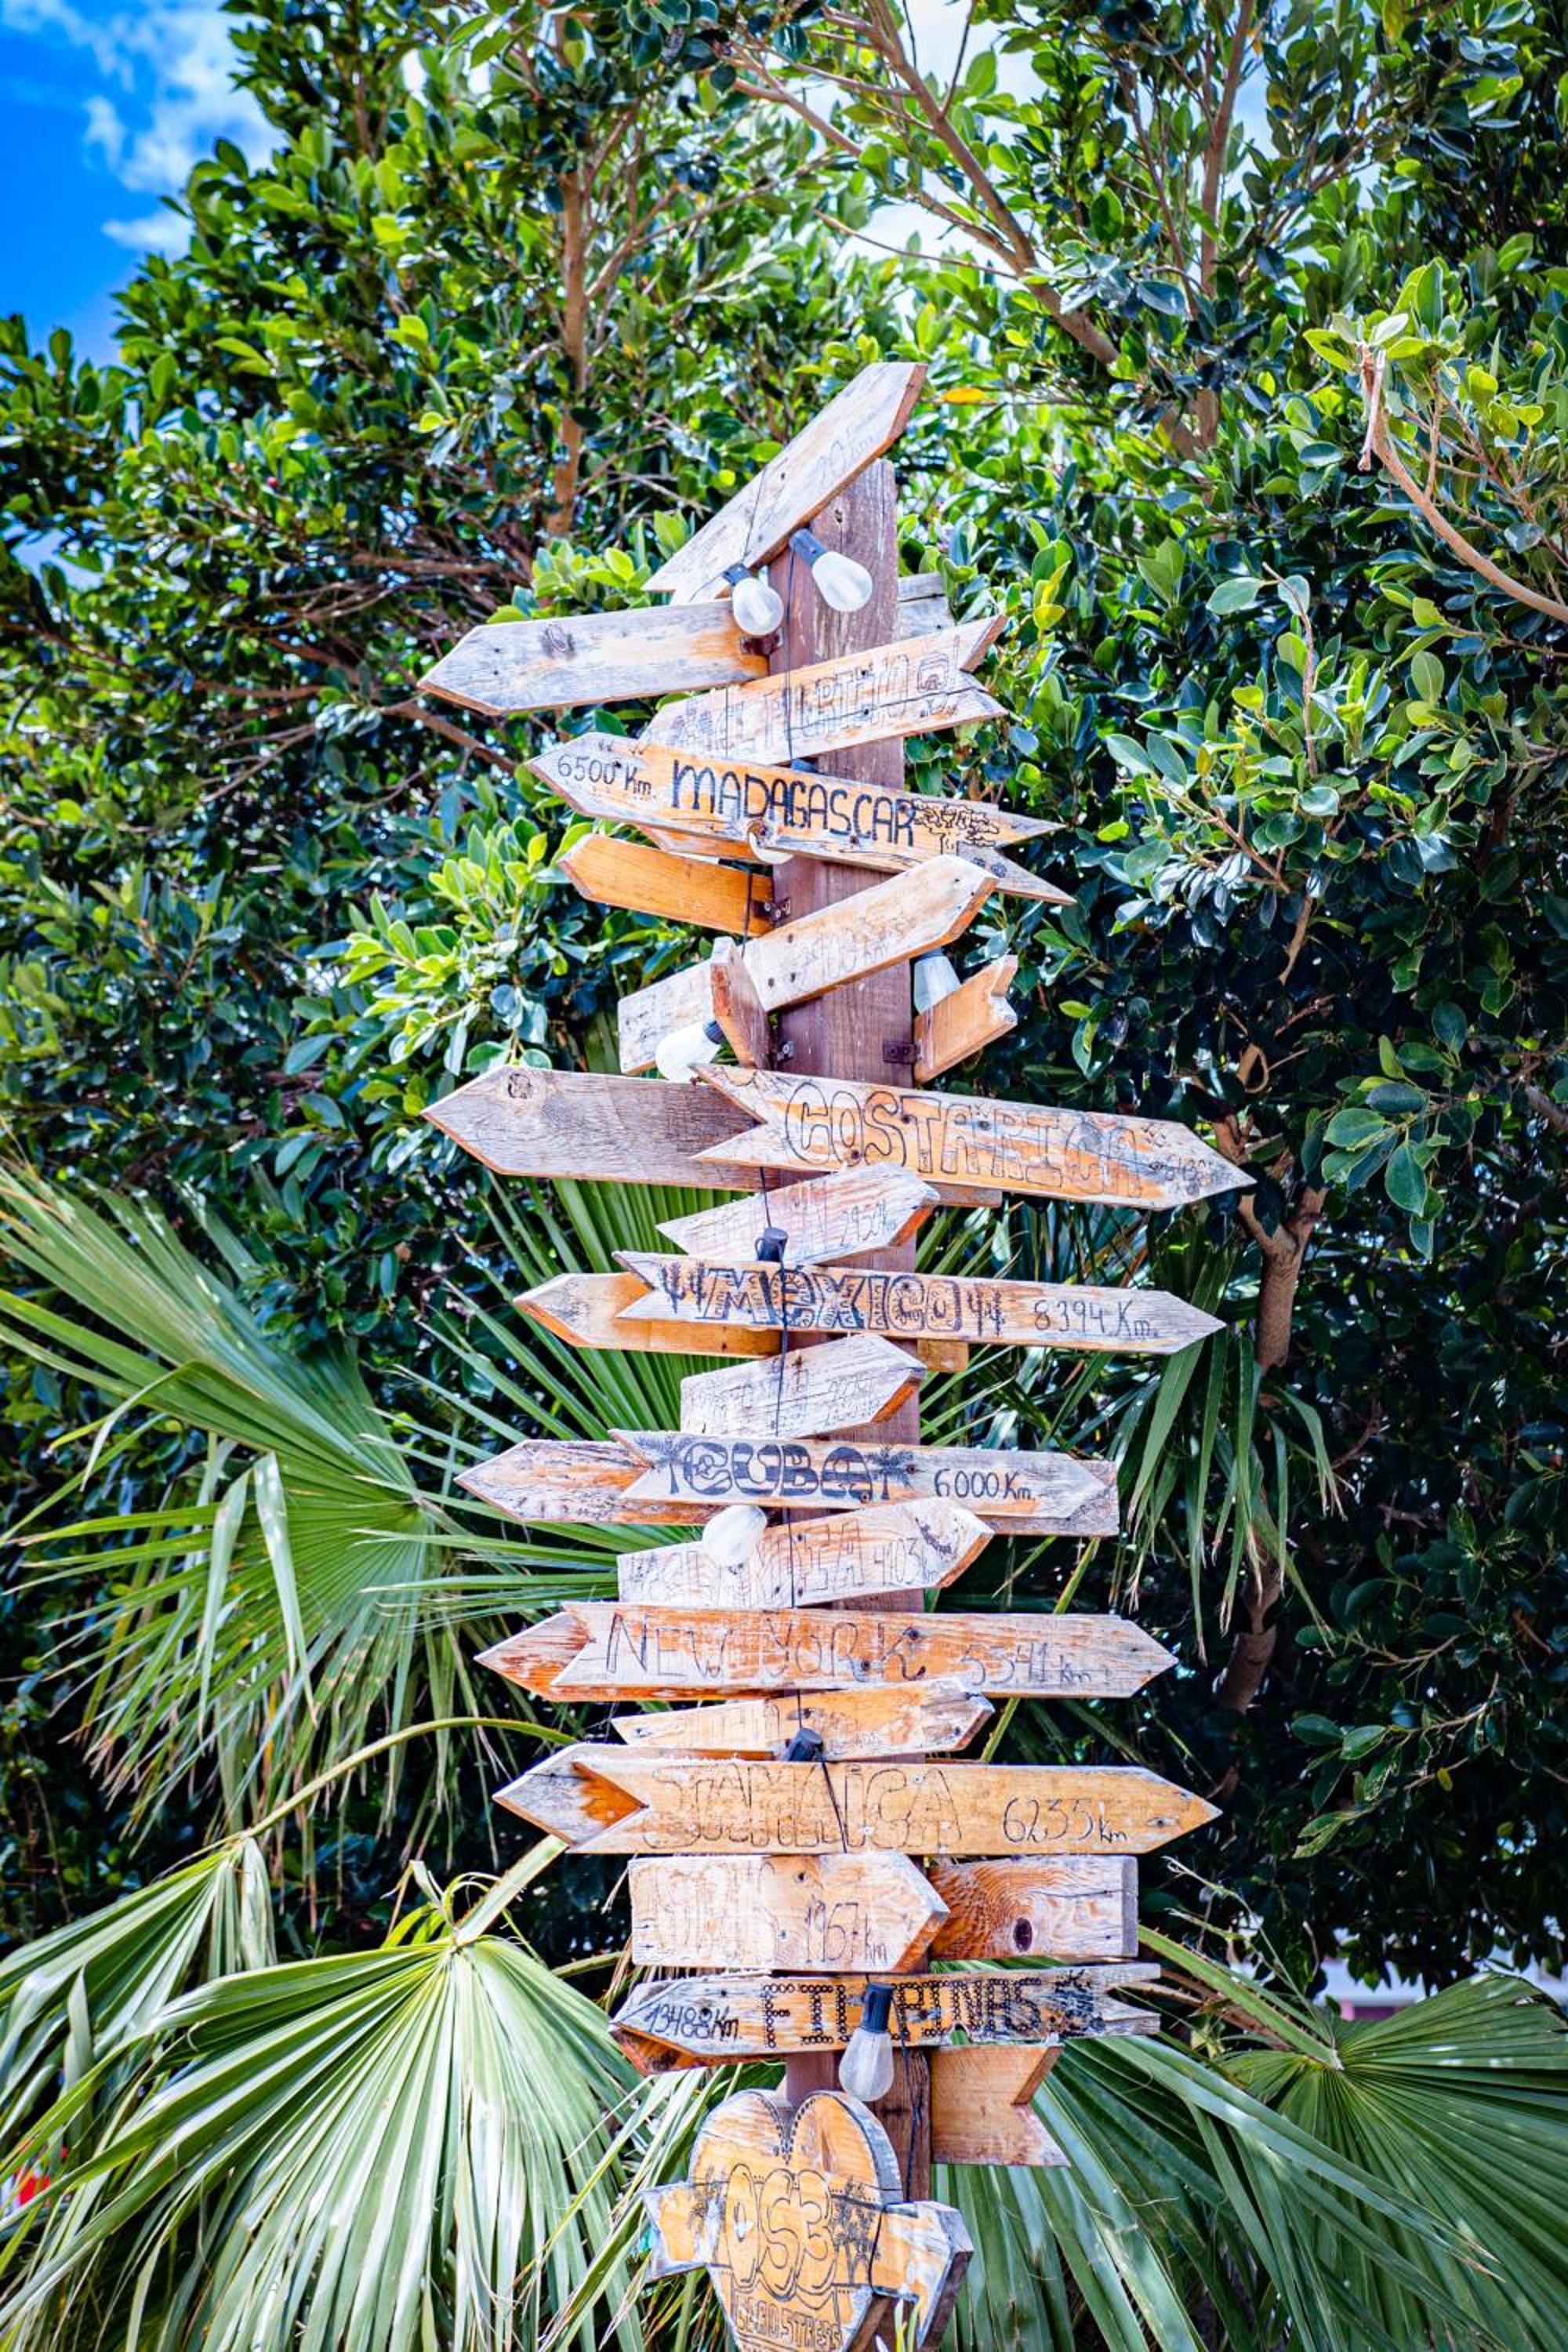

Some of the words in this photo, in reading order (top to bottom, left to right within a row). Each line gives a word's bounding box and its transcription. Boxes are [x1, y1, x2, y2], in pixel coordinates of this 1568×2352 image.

[557, 753, 617, 785] 6500
[671, 759, 916, 847] MADAGASCAR
[786, 1081, 981, 1176] COSTA
[990, 1108, 1142, 1197] RICA
[703, 1267, 963, 1331] MEXICO
[1033, 1298, 1105, 1334] 8394
[684, 1441, 873, 1499] CUBA
[934, 1468, 1000, 1499] 6000
[606, 1612, 735, 1679] NEW
[1003, 1797, 1094, 1842] 6235
[763, 1976, 1043, 2049] FILPINAS
